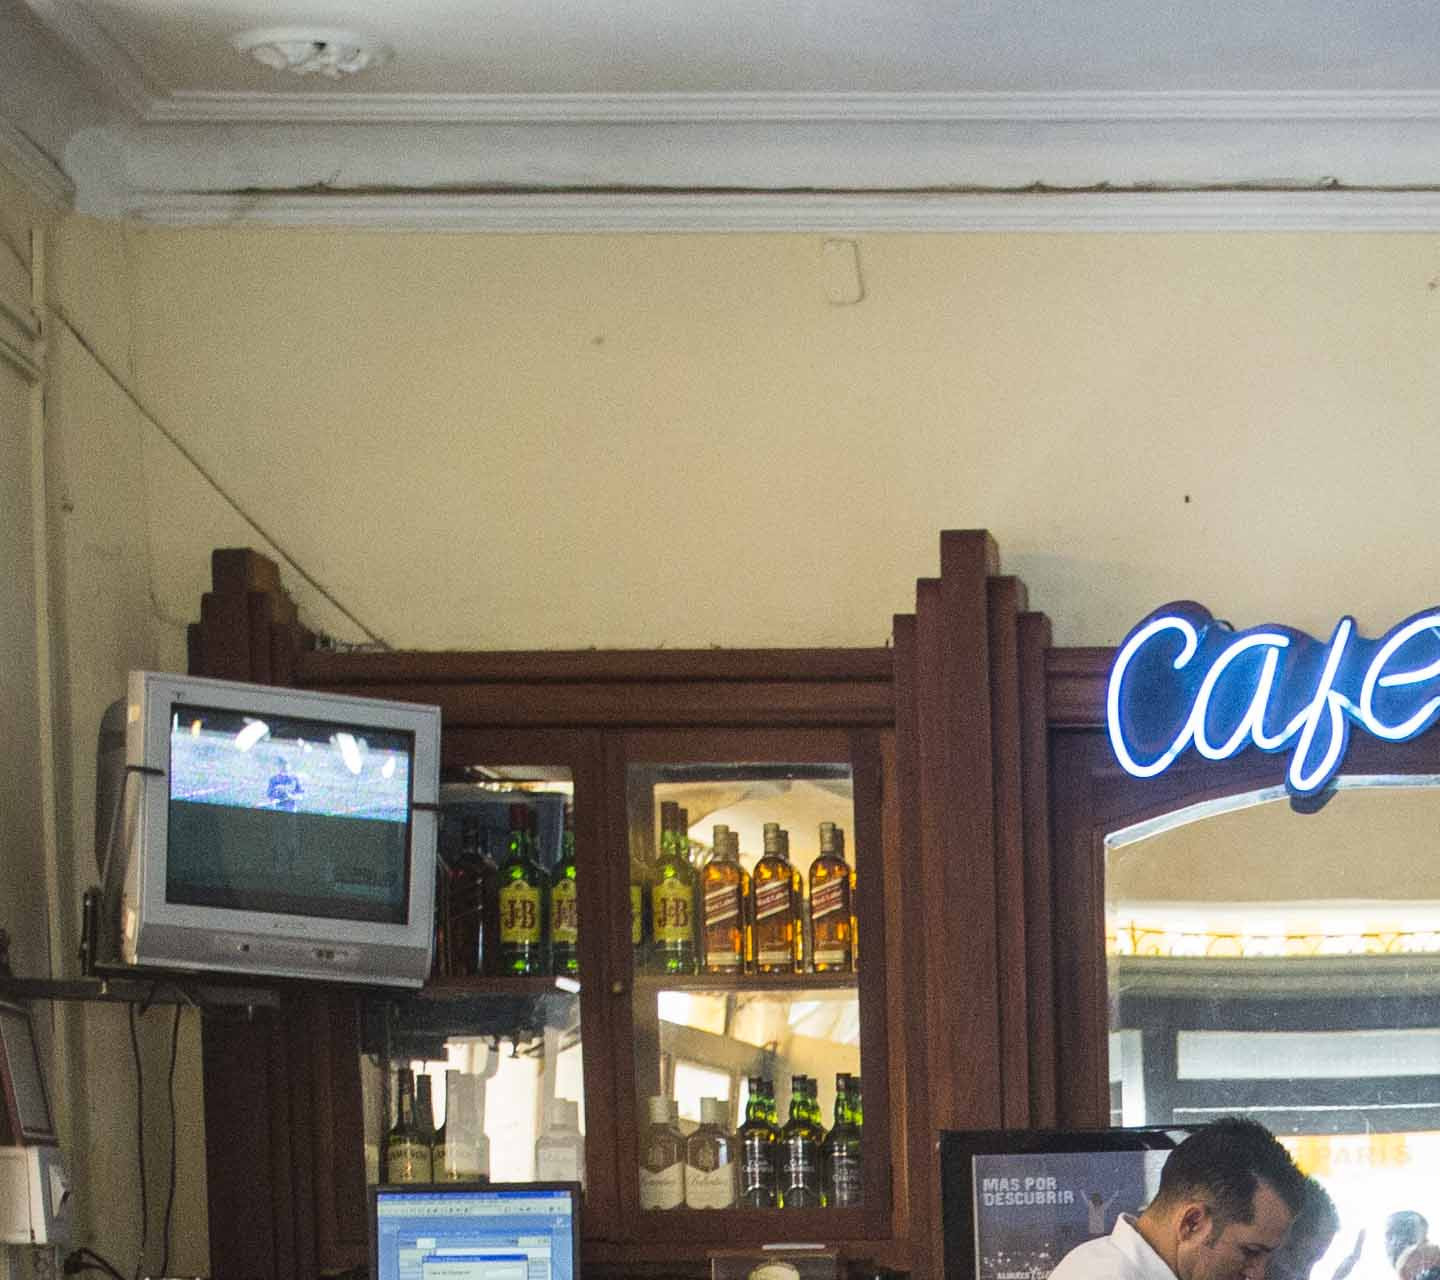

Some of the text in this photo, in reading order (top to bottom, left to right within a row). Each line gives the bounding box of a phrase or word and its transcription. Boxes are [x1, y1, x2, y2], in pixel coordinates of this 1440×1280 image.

[983, 1177, 1057, 1192] MAS POR
[983, 1190, 1074, 1206] DESCUBRIR
